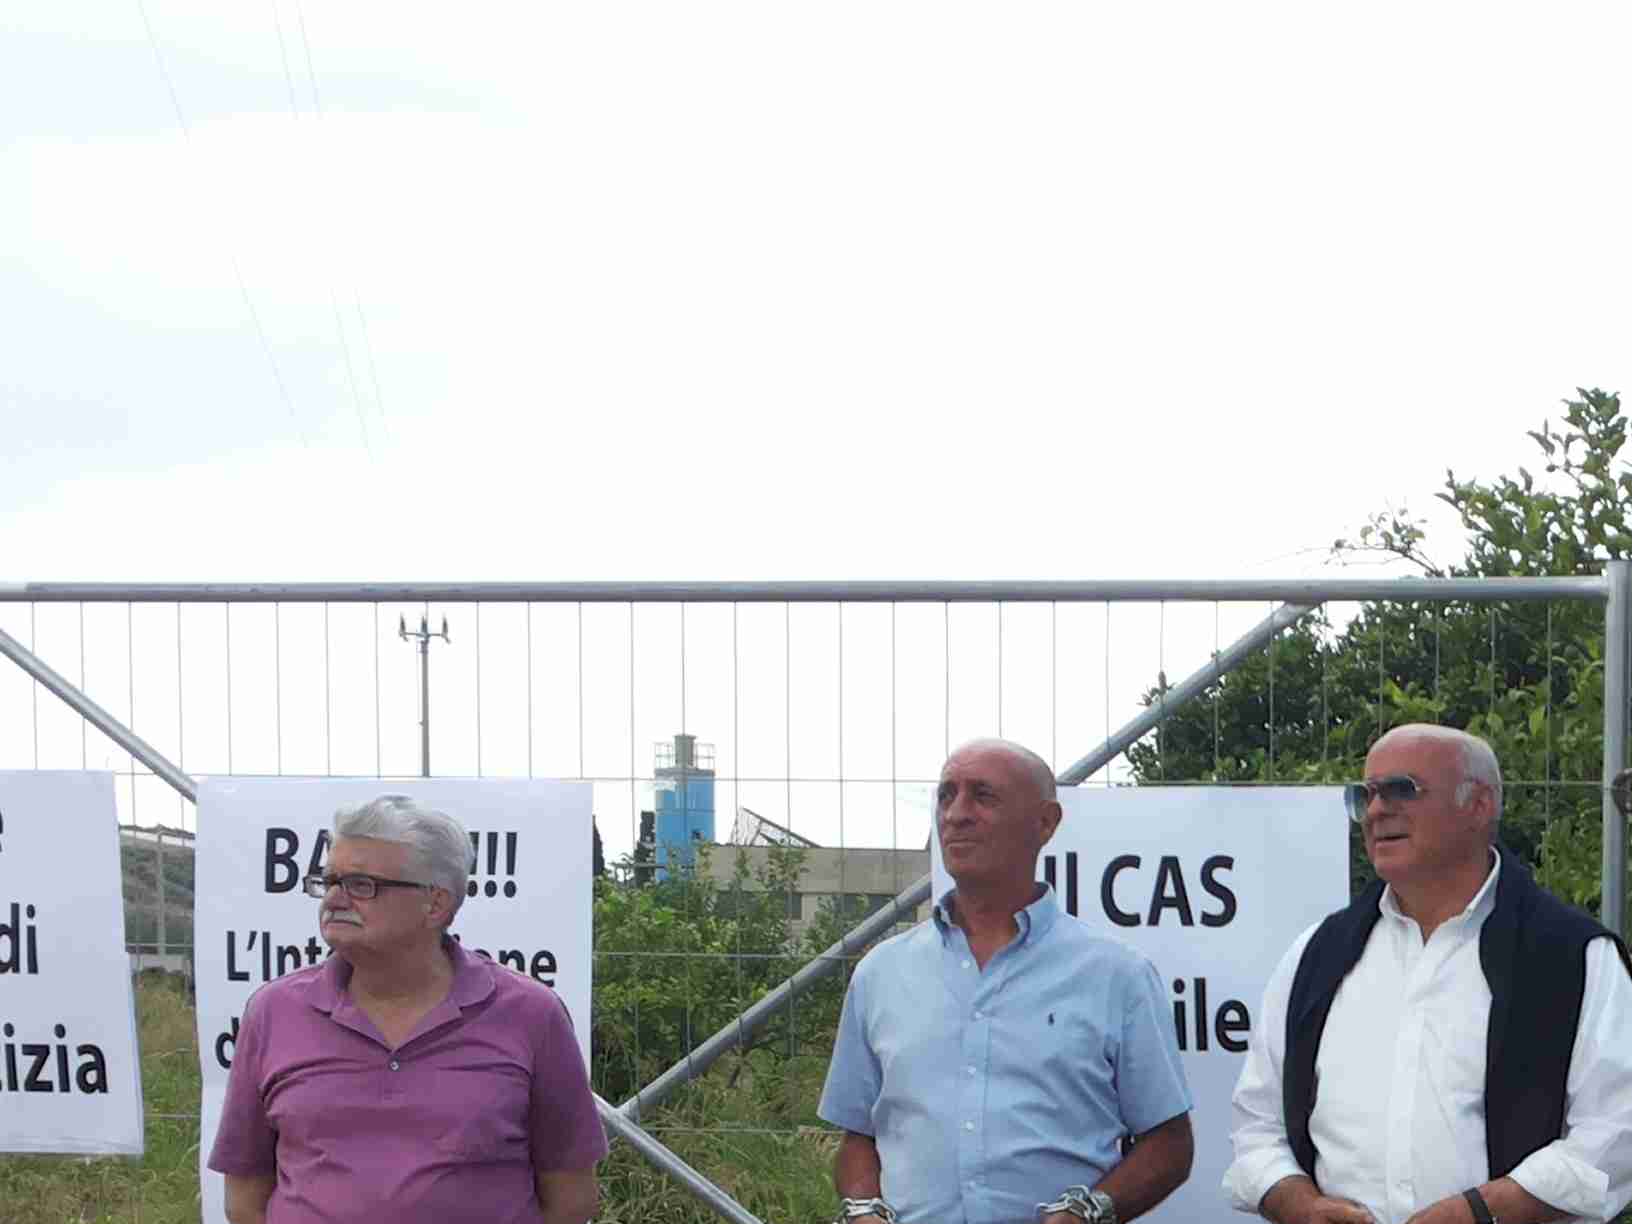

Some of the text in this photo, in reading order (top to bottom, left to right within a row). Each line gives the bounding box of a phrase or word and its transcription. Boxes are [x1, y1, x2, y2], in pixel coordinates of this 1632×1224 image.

[1100, 854, 1237, 928] CAS
[1172, 977, 1252, 1054] ile
[0, 1022, 109, 1095] izia
